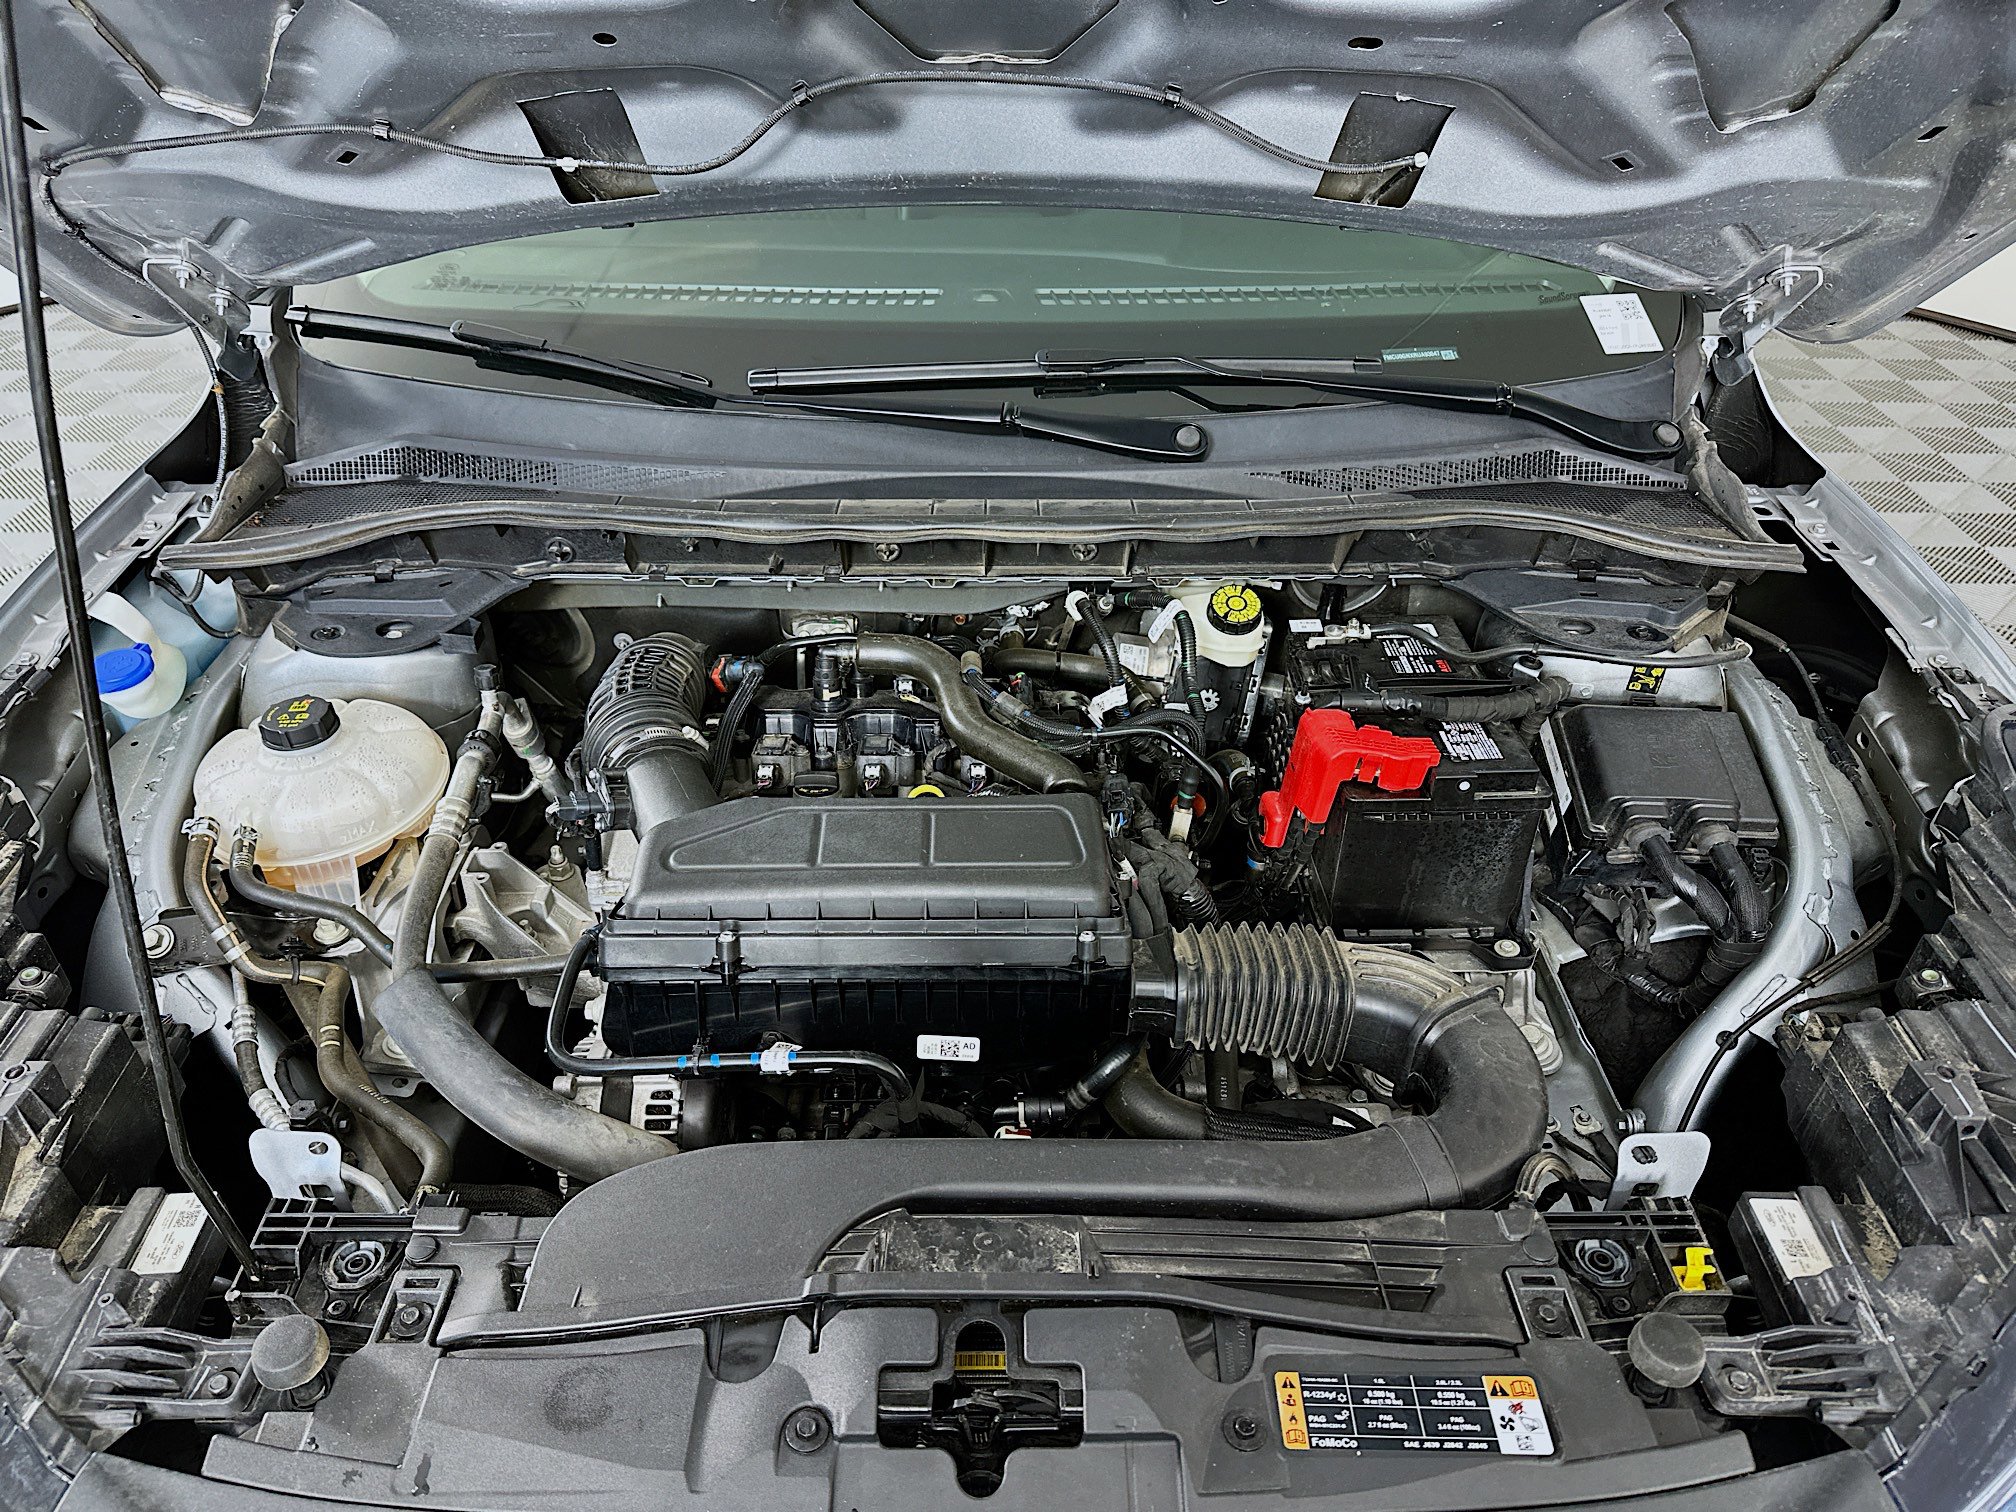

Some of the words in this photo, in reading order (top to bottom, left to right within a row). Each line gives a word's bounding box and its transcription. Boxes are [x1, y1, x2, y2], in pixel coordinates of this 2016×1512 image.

[963, 1042, 976, 1050] AD
[1303, 1390, 1336, 1400] R-1234yf
[1307, 1415, 1327, 1423] PAG
[1379, 1414, 1394, 1422] PAG
[1311, 1437, 1358, 1448] FoMoCo
[1403, 1440, 1421, 1448] SAE
